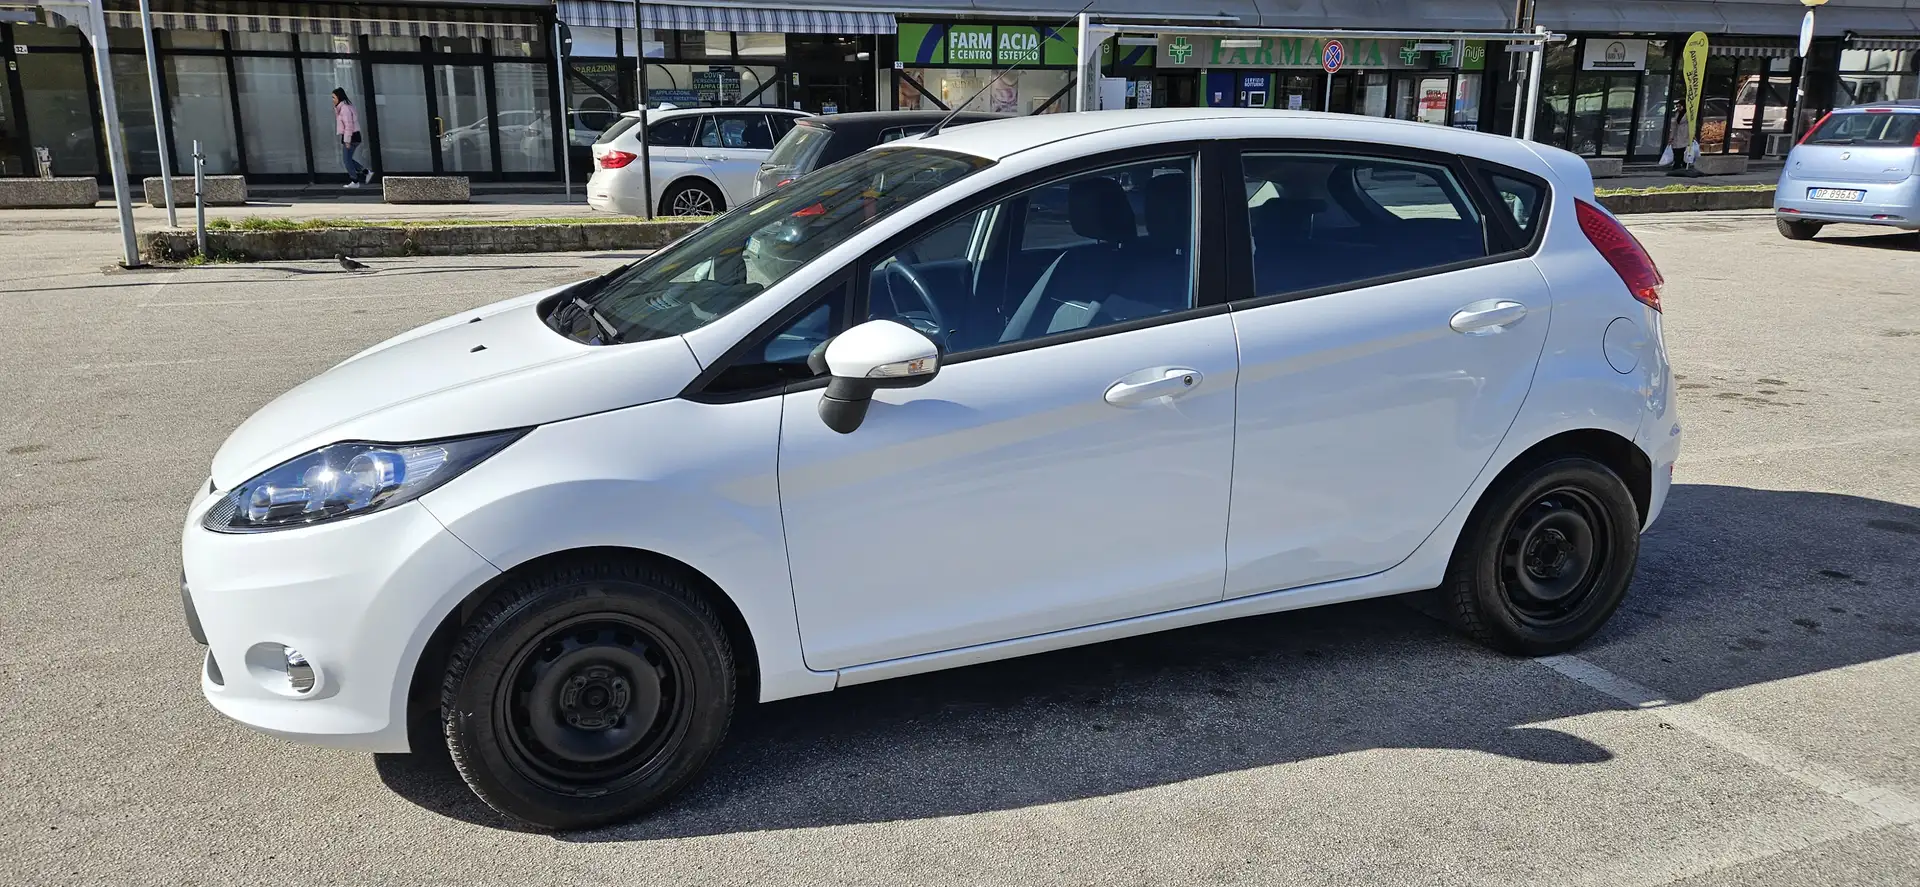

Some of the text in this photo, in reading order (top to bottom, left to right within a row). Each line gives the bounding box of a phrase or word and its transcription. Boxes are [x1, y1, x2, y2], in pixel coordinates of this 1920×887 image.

[950, 50, 1038, 60] E CENTRO ESTETICO
[1208, 38, 1385, 65] FARMAIA
[573, 64, 616, 74] PARAZIONI
